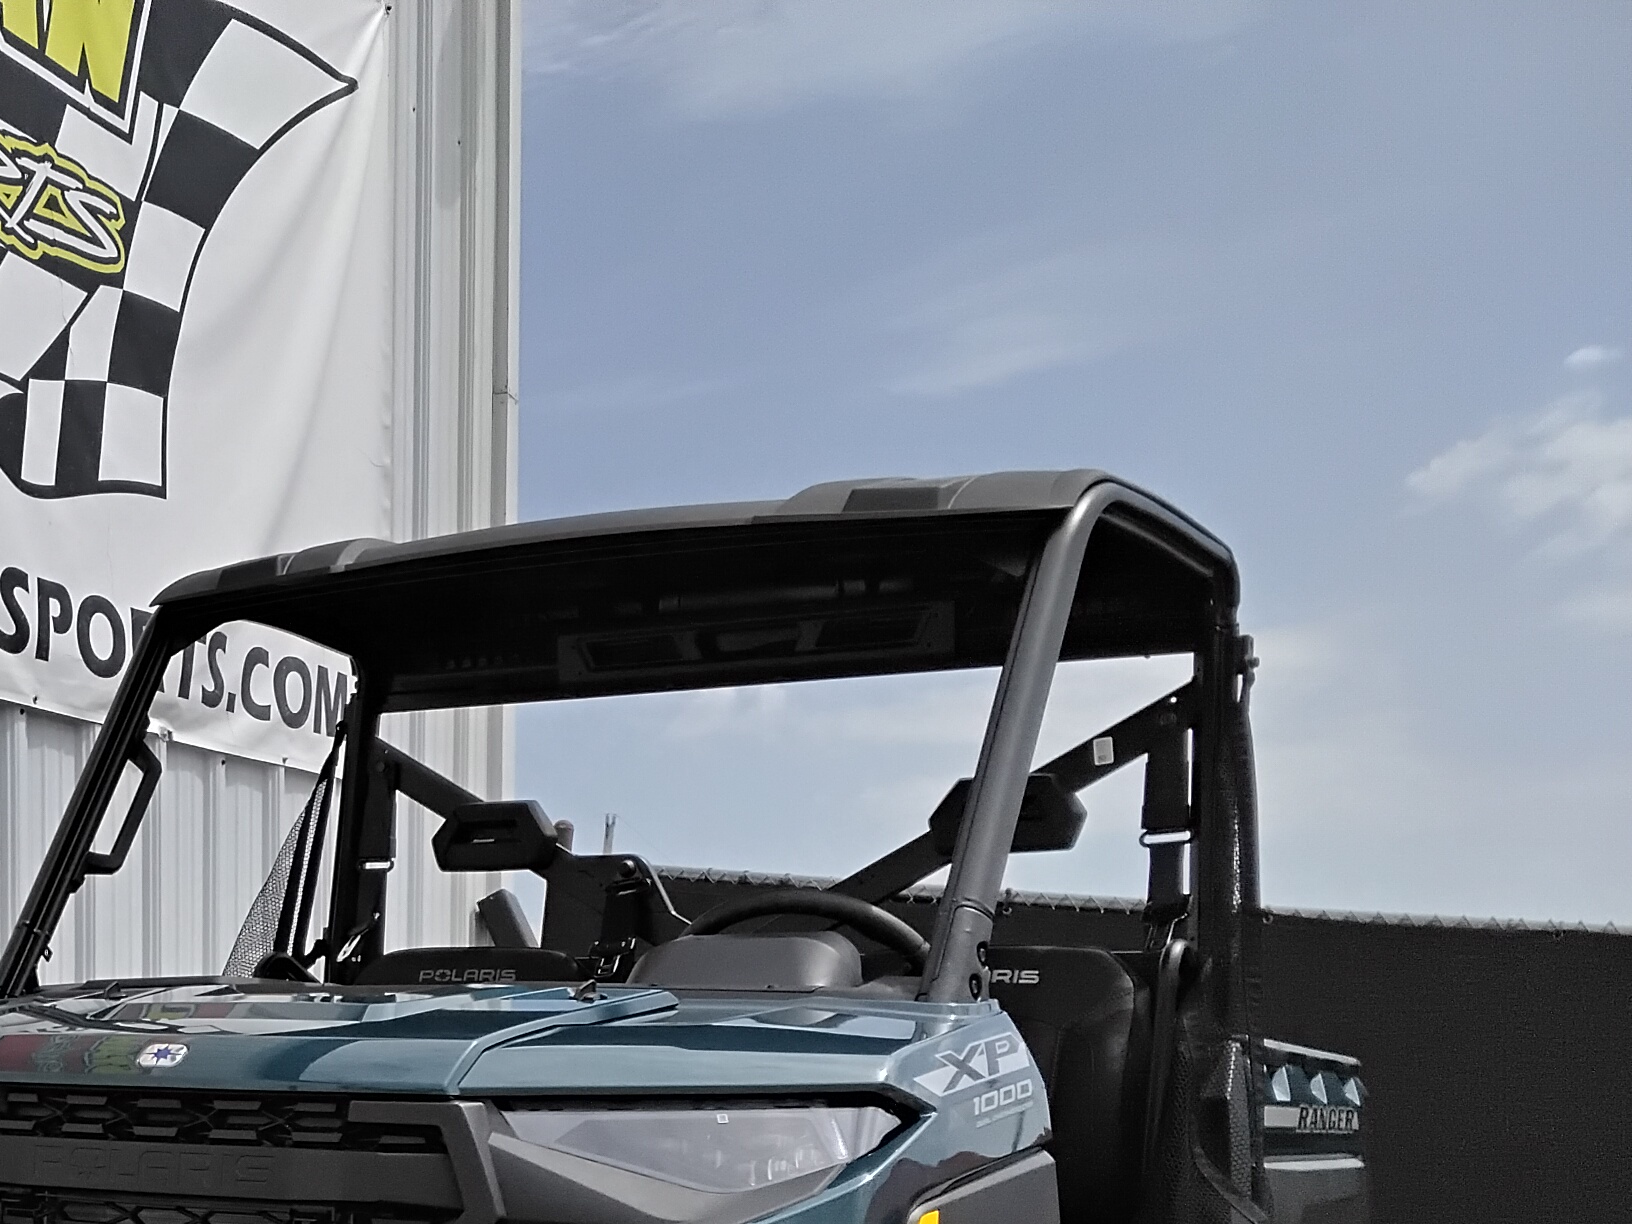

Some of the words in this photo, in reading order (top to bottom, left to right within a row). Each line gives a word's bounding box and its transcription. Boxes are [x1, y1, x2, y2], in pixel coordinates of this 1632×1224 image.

[418, 968, 517, 984] POLARIS
[935, 1031, 1021, 1094] XP
[972, 1078, 1033, 1117] 1000
[1297, 1105, 1355, 1133] RANGER
[33, 1143, 277, 1187] POLARIS
